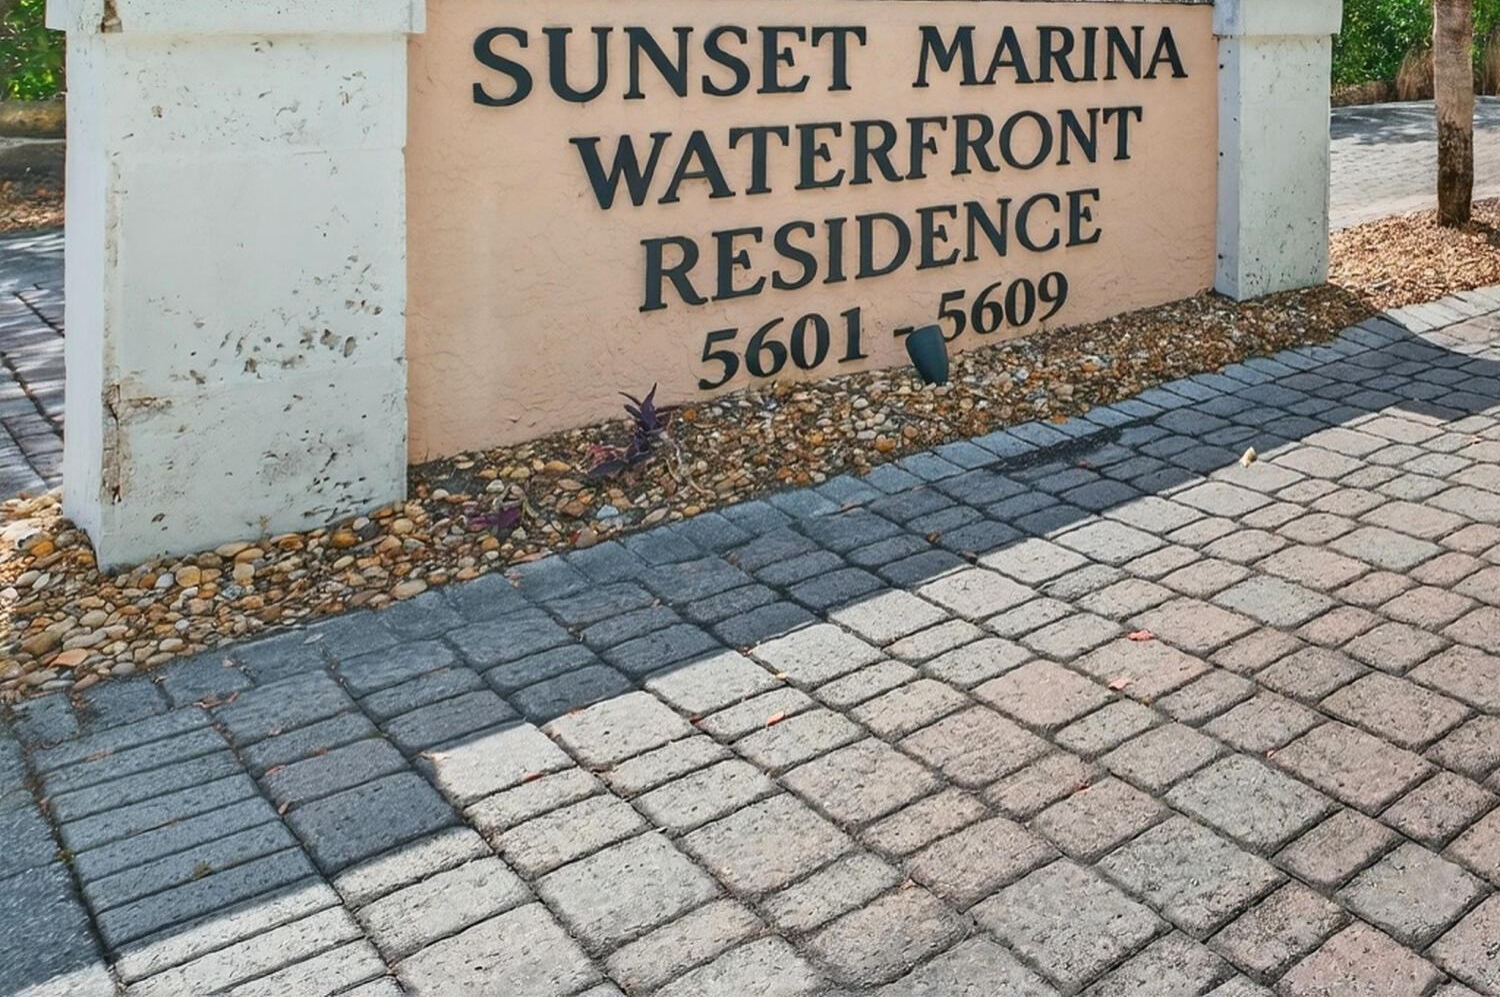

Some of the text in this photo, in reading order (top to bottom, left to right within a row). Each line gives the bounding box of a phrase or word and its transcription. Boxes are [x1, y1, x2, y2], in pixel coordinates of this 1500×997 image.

[472, 25, 1189, 108] SUNSET MARINA
[569, 105, 1143, 211] WATERFRONT
[638, 187, 1103, 314] RESIDENCE
[698, 306, 869, 391] 5601
[937, 271, 1069, 343] 5609
